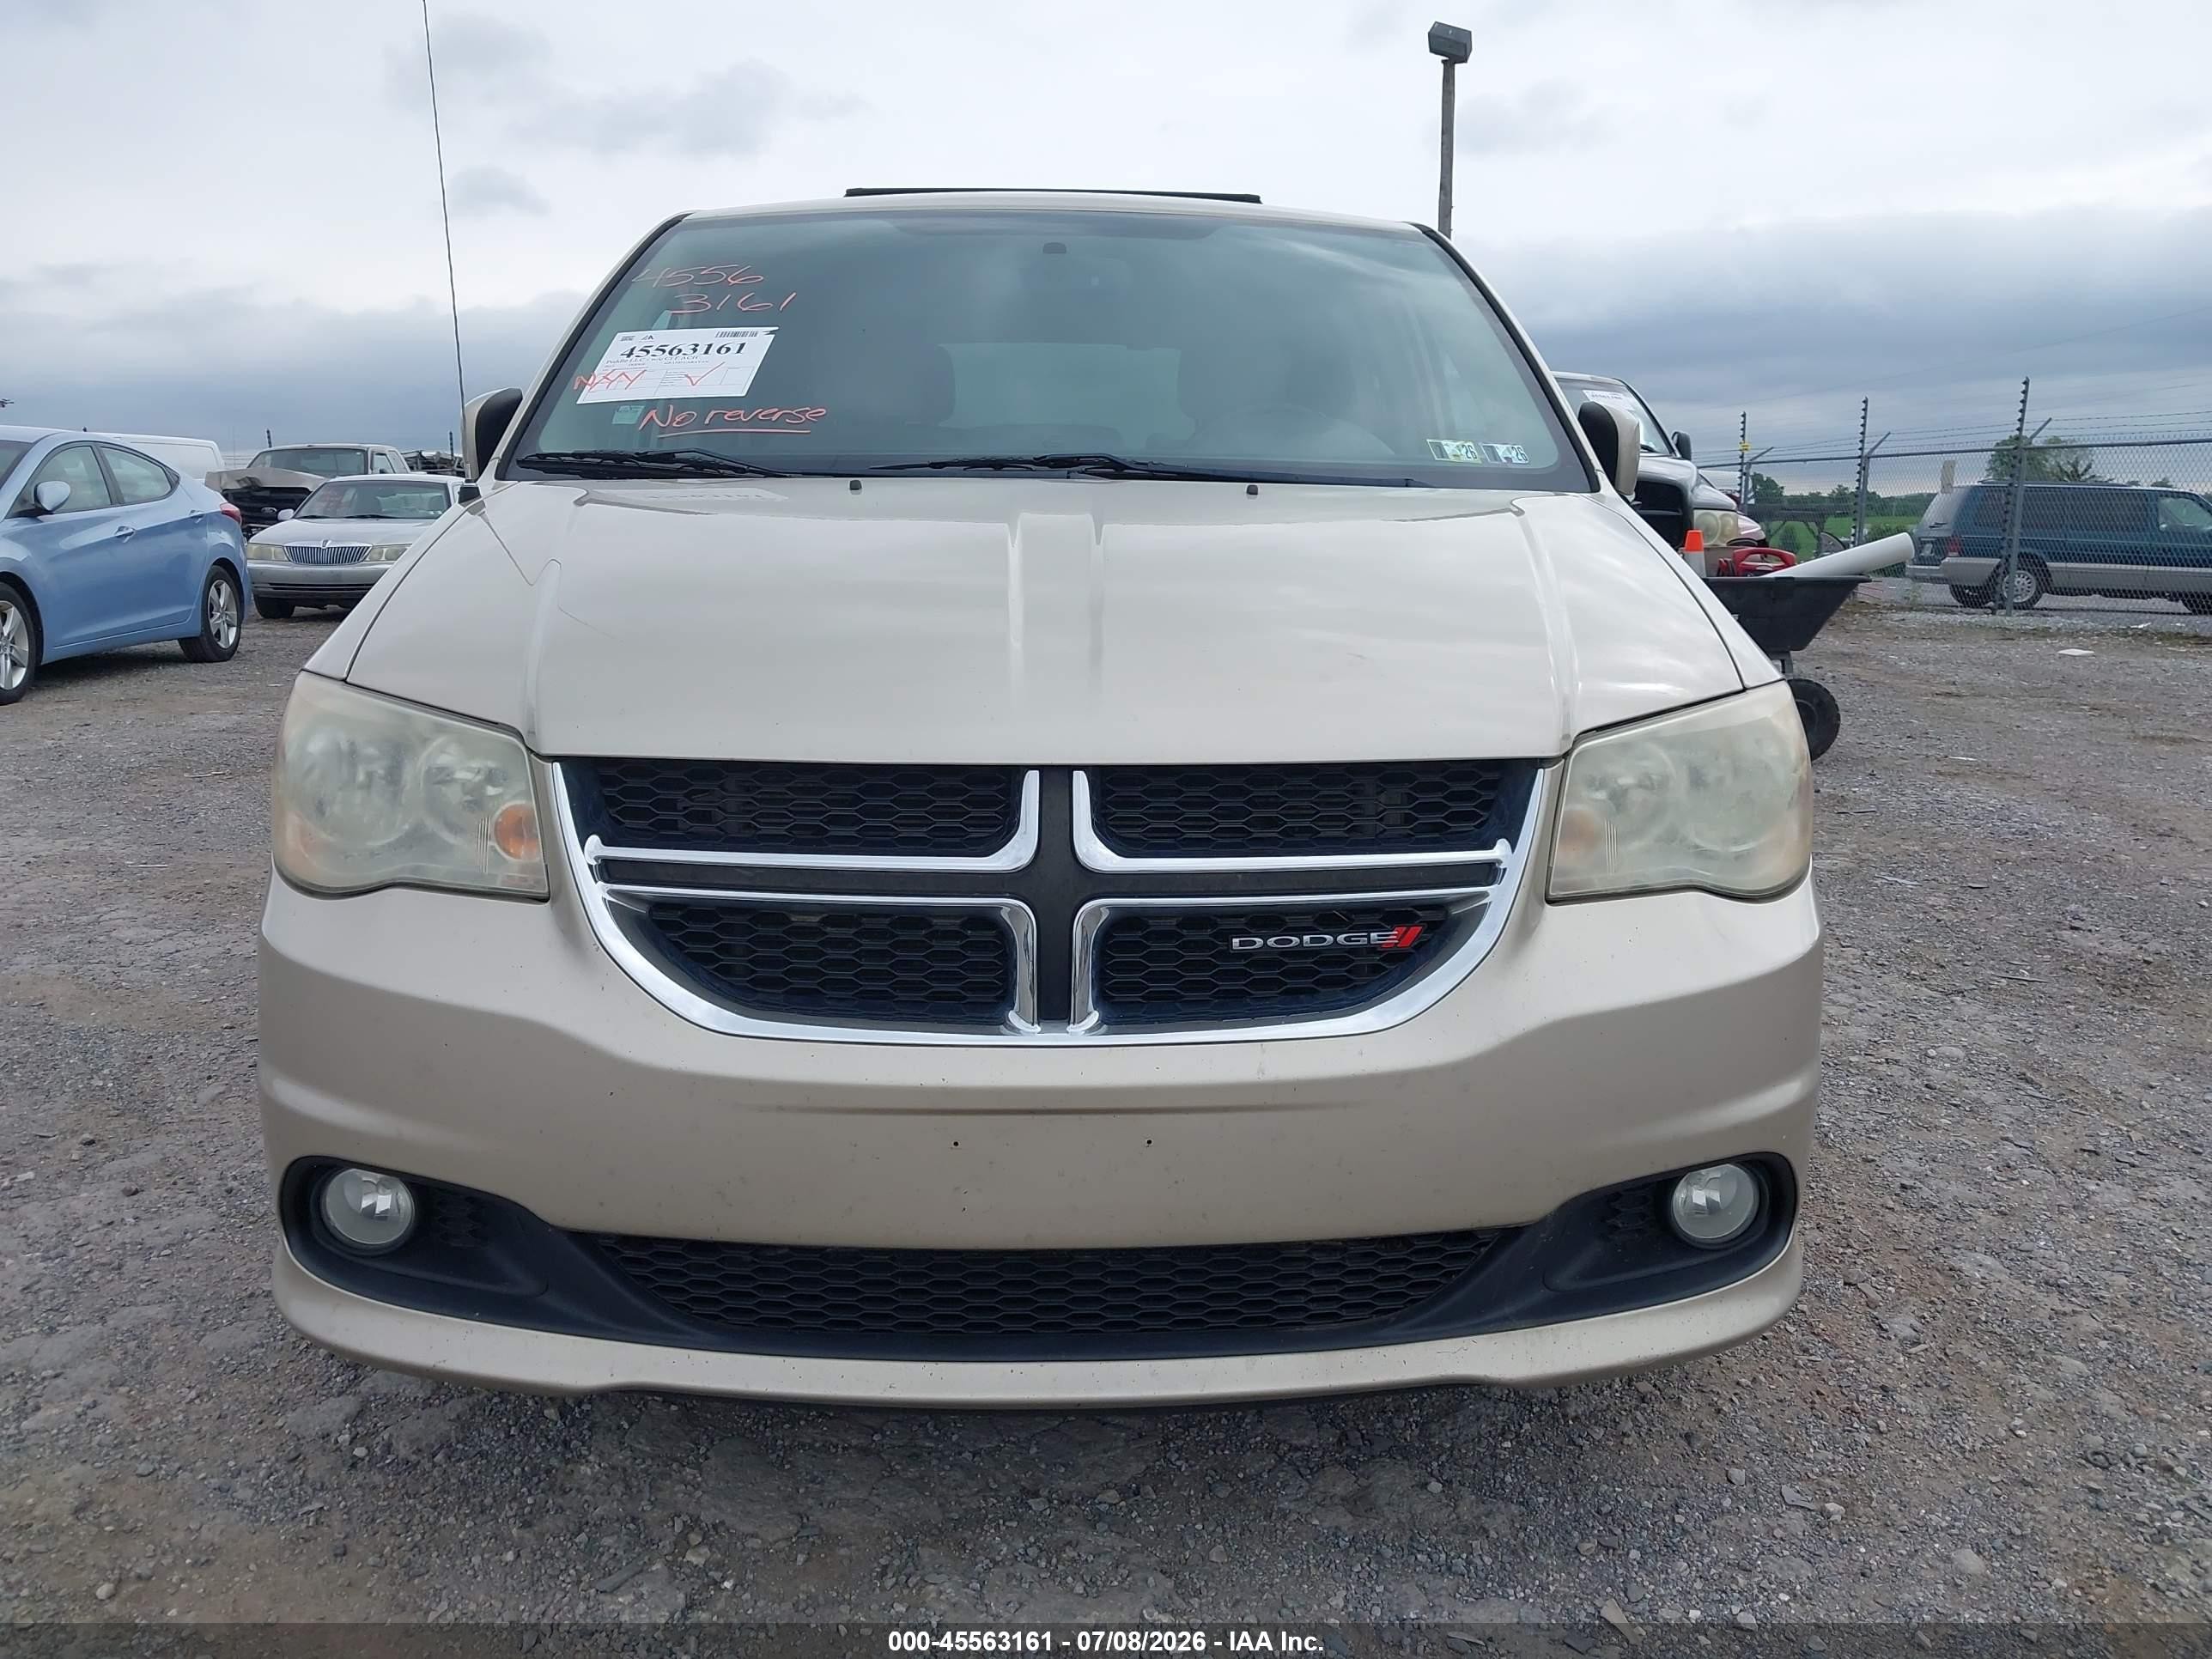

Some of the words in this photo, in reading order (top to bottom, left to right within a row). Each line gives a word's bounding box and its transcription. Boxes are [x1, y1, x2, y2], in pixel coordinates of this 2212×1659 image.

[632, 264, 764, 288] 4556
[670, 292, 797, 313] 3161
[621, 343, 746, 358] 45563161
[638, 405, 697, 430] No
[704, 407, 827, 424] reverse
[1462, 444, 1478, 459] 26
[1512, 446, 1528, 461] 26
[1231, 931, 1399, 950] DODGE
